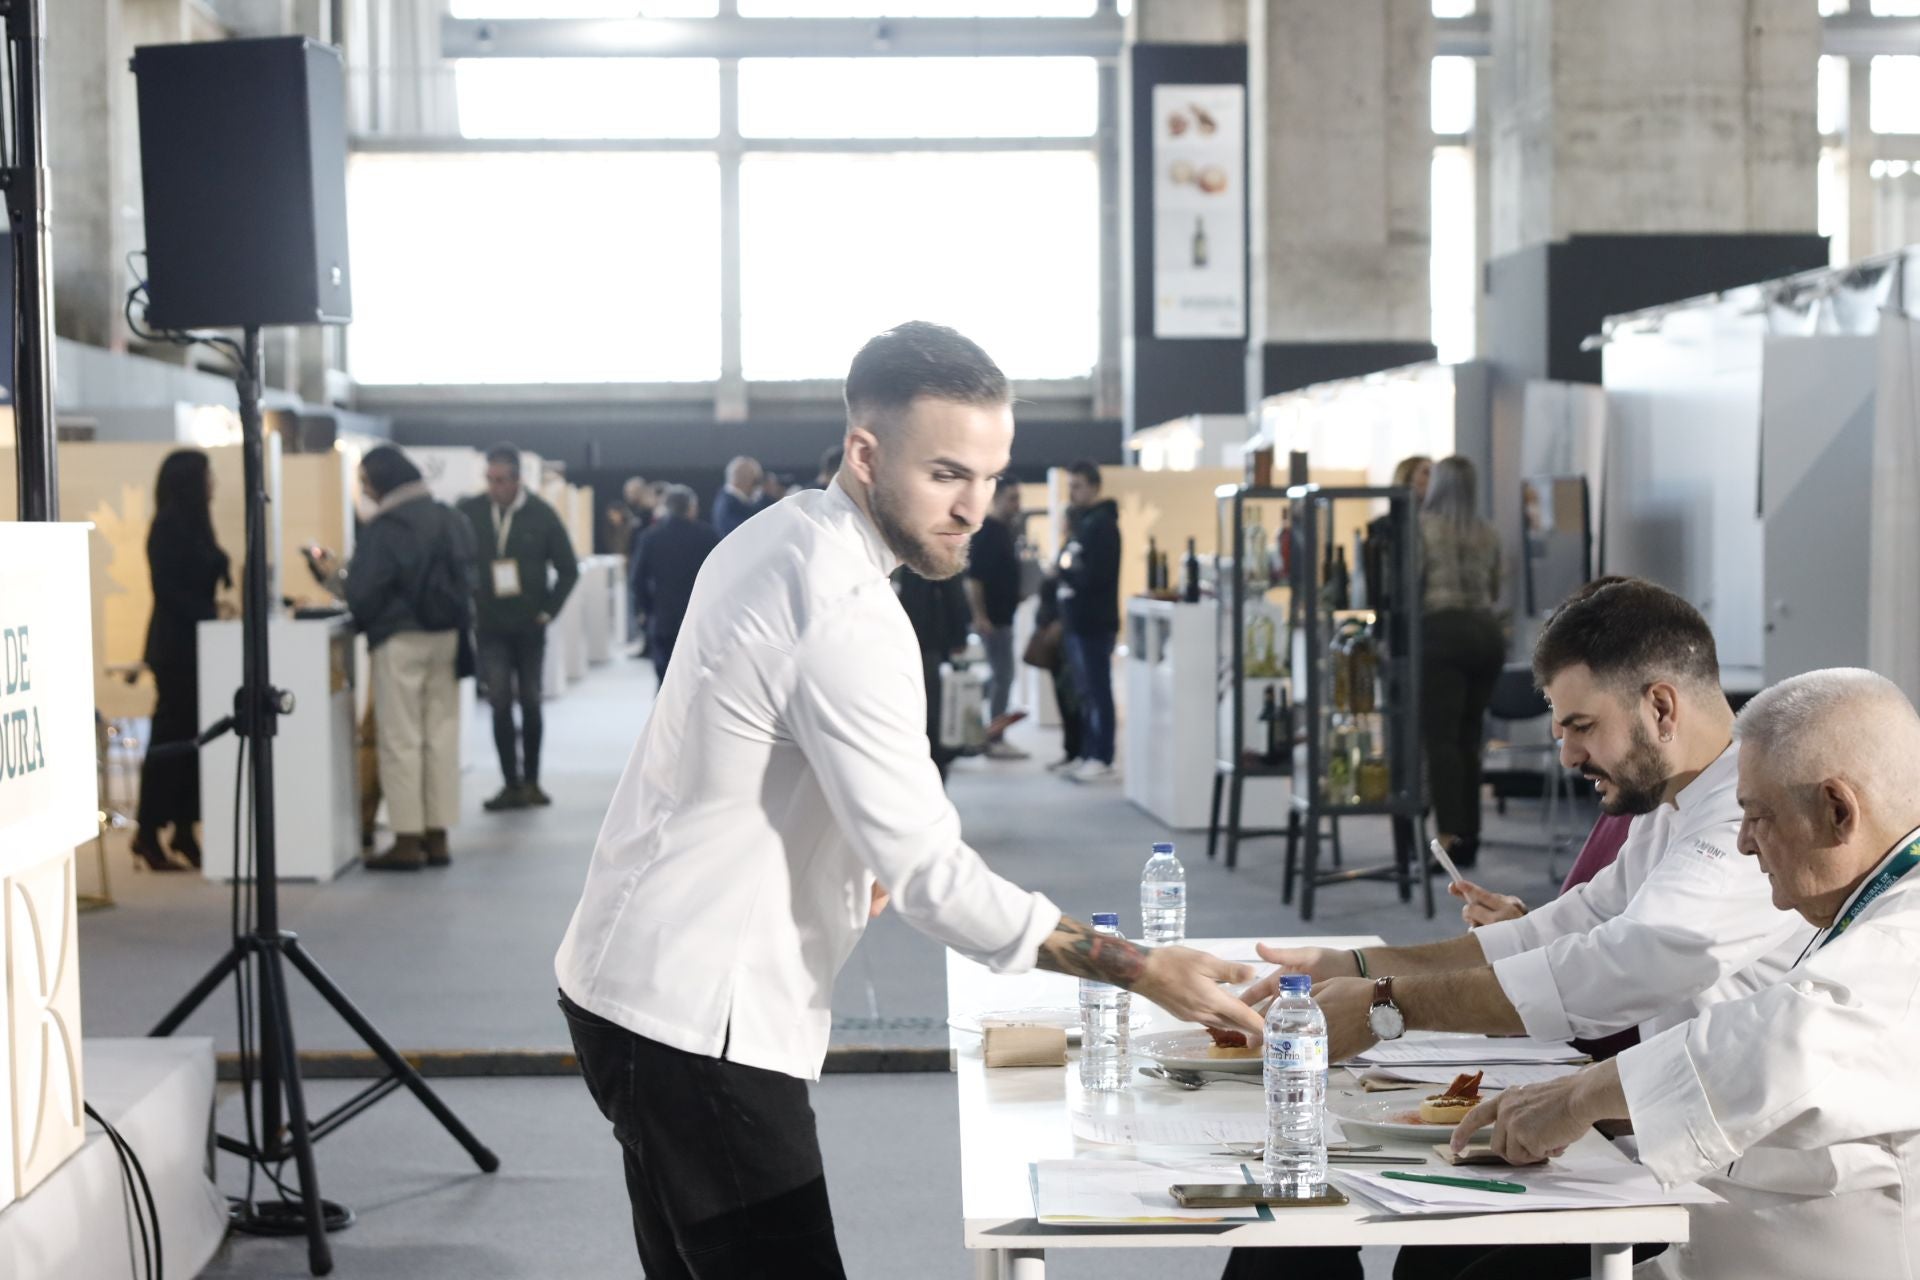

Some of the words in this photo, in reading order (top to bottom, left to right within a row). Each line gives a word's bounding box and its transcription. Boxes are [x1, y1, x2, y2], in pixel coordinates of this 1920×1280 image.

[3, 624, 31, 695] DE
[1851, 901, 1865, 916] CAJA
[1863, 882, 1882, 902] RURAL
[1881, 872, 1890, 884] DE
